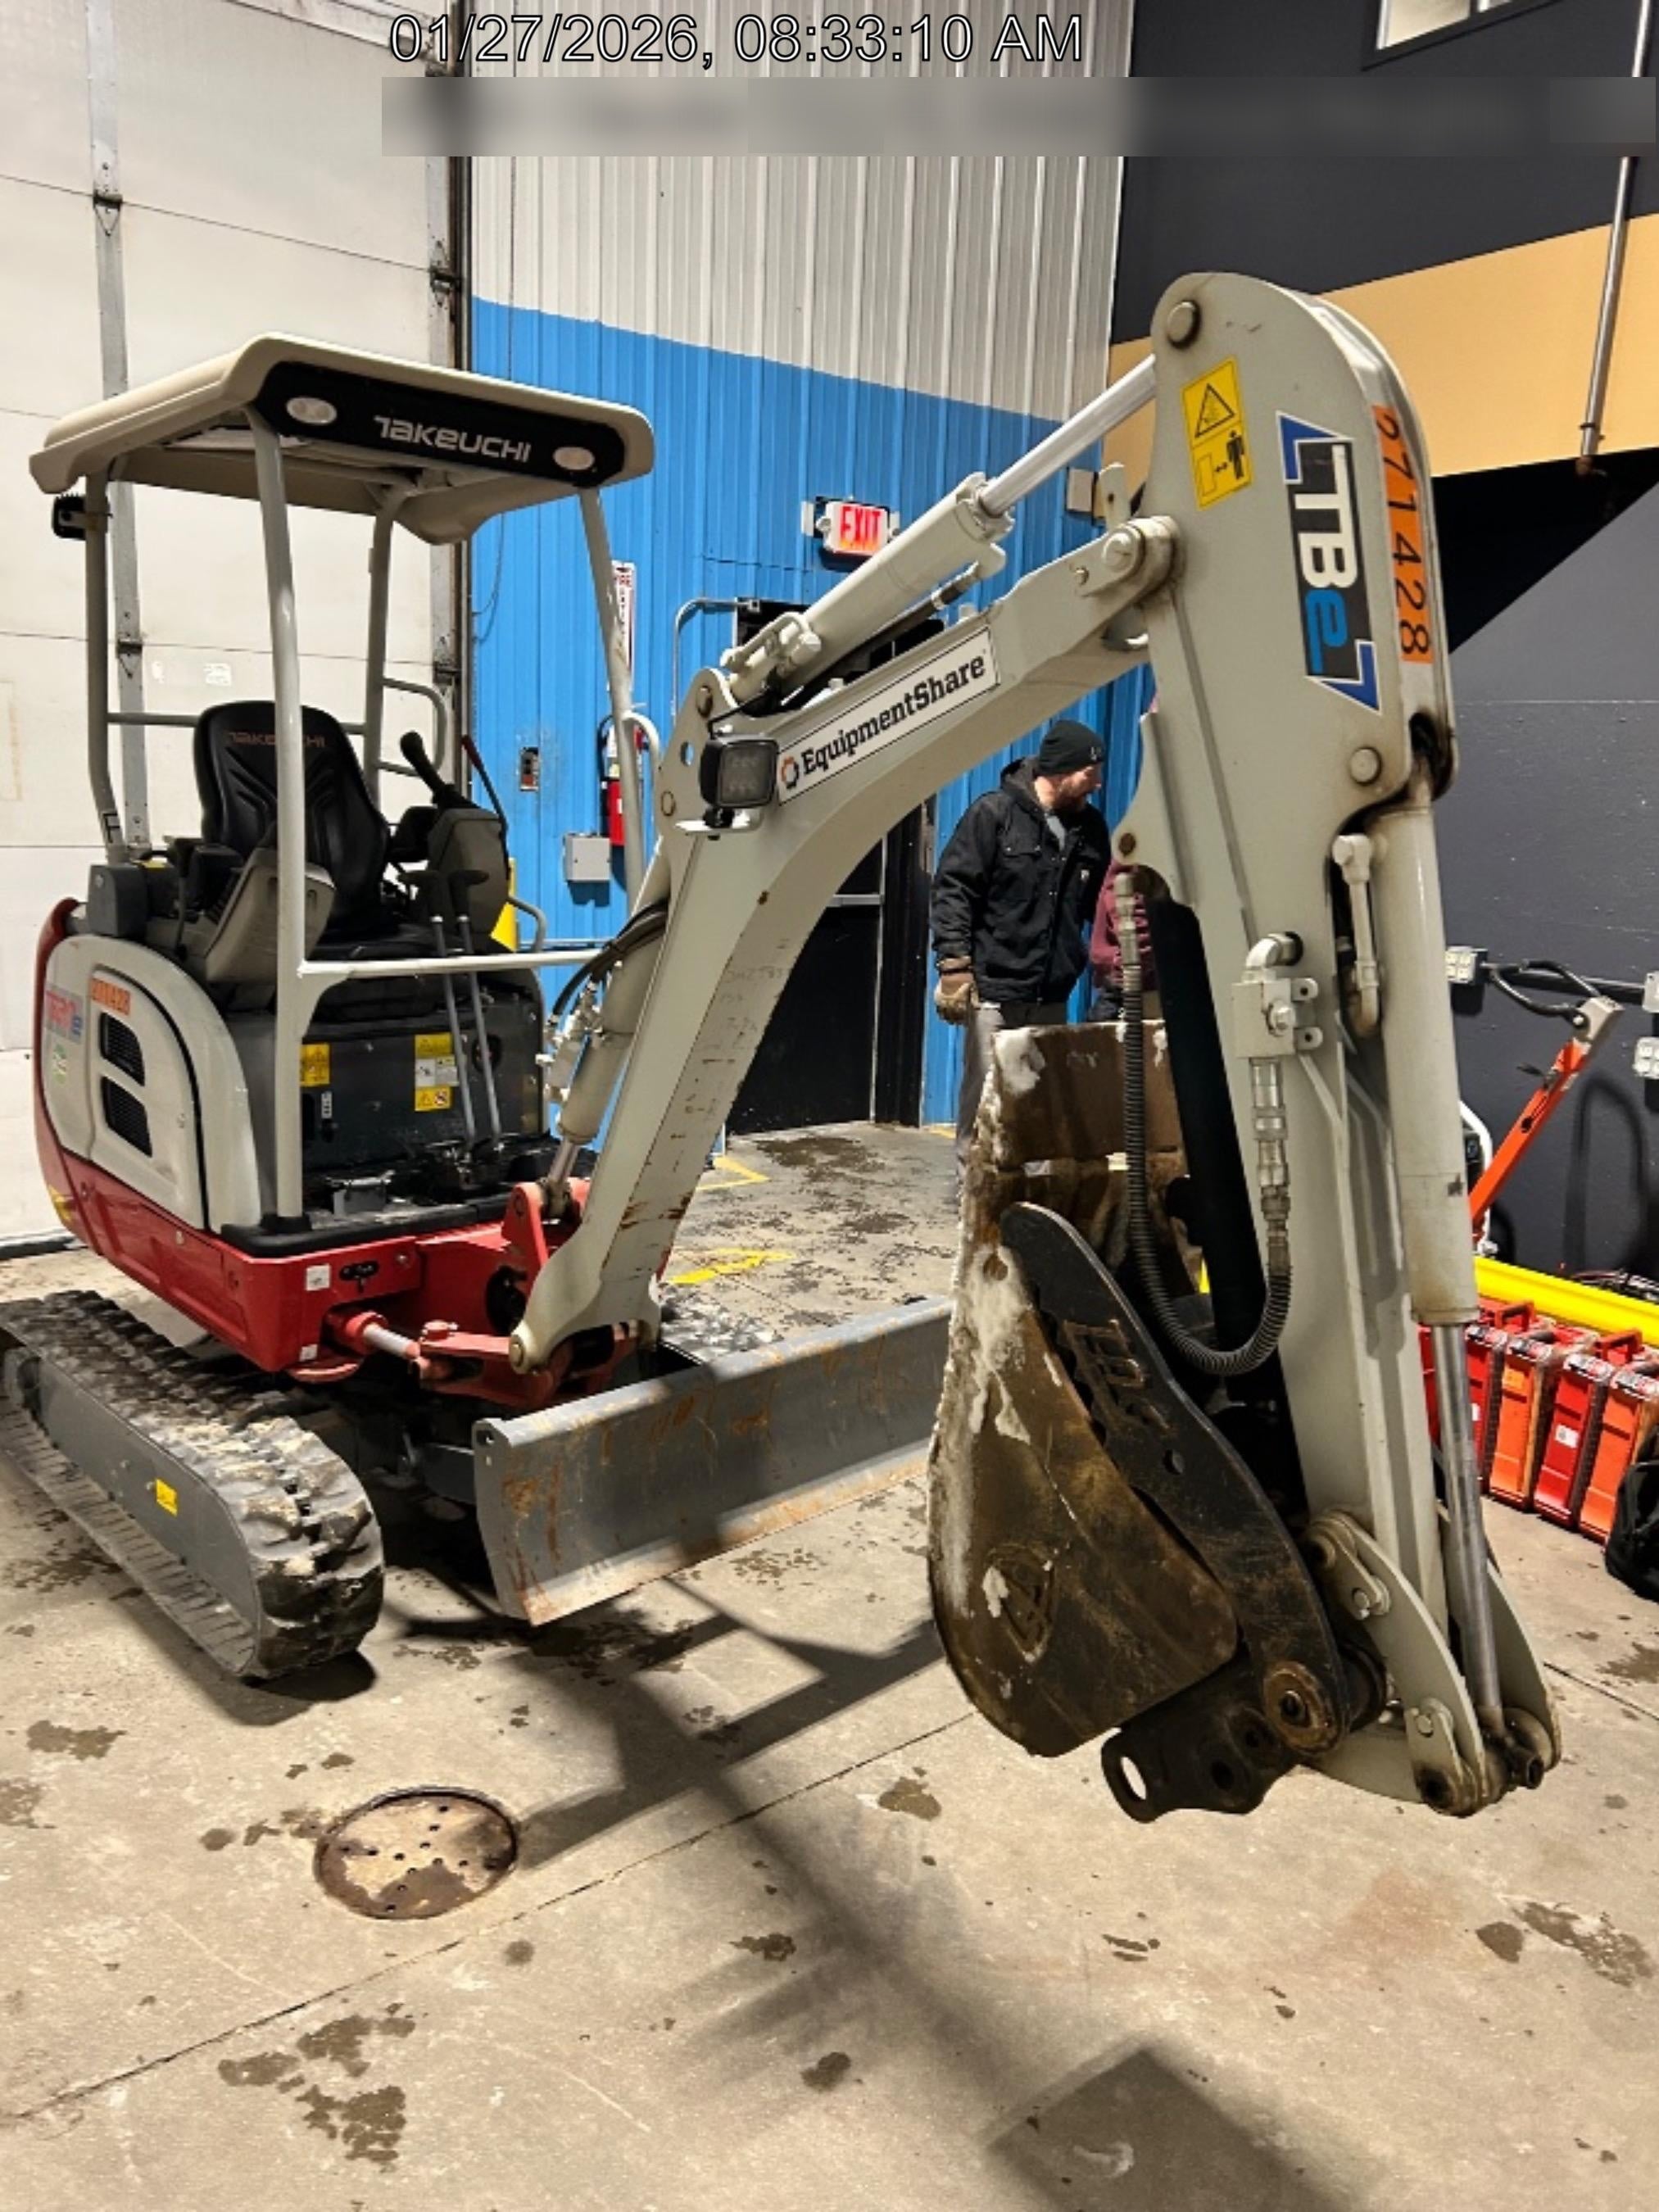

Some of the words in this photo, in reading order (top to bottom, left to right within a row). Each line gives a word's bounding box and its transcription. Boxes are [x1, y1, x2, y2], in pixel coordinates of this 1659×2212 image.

[840, 505, 882, 548] EXIT
[1376, 414, 1430, 655] 271428
[801, 655, 986, 775] EquipmentShare
